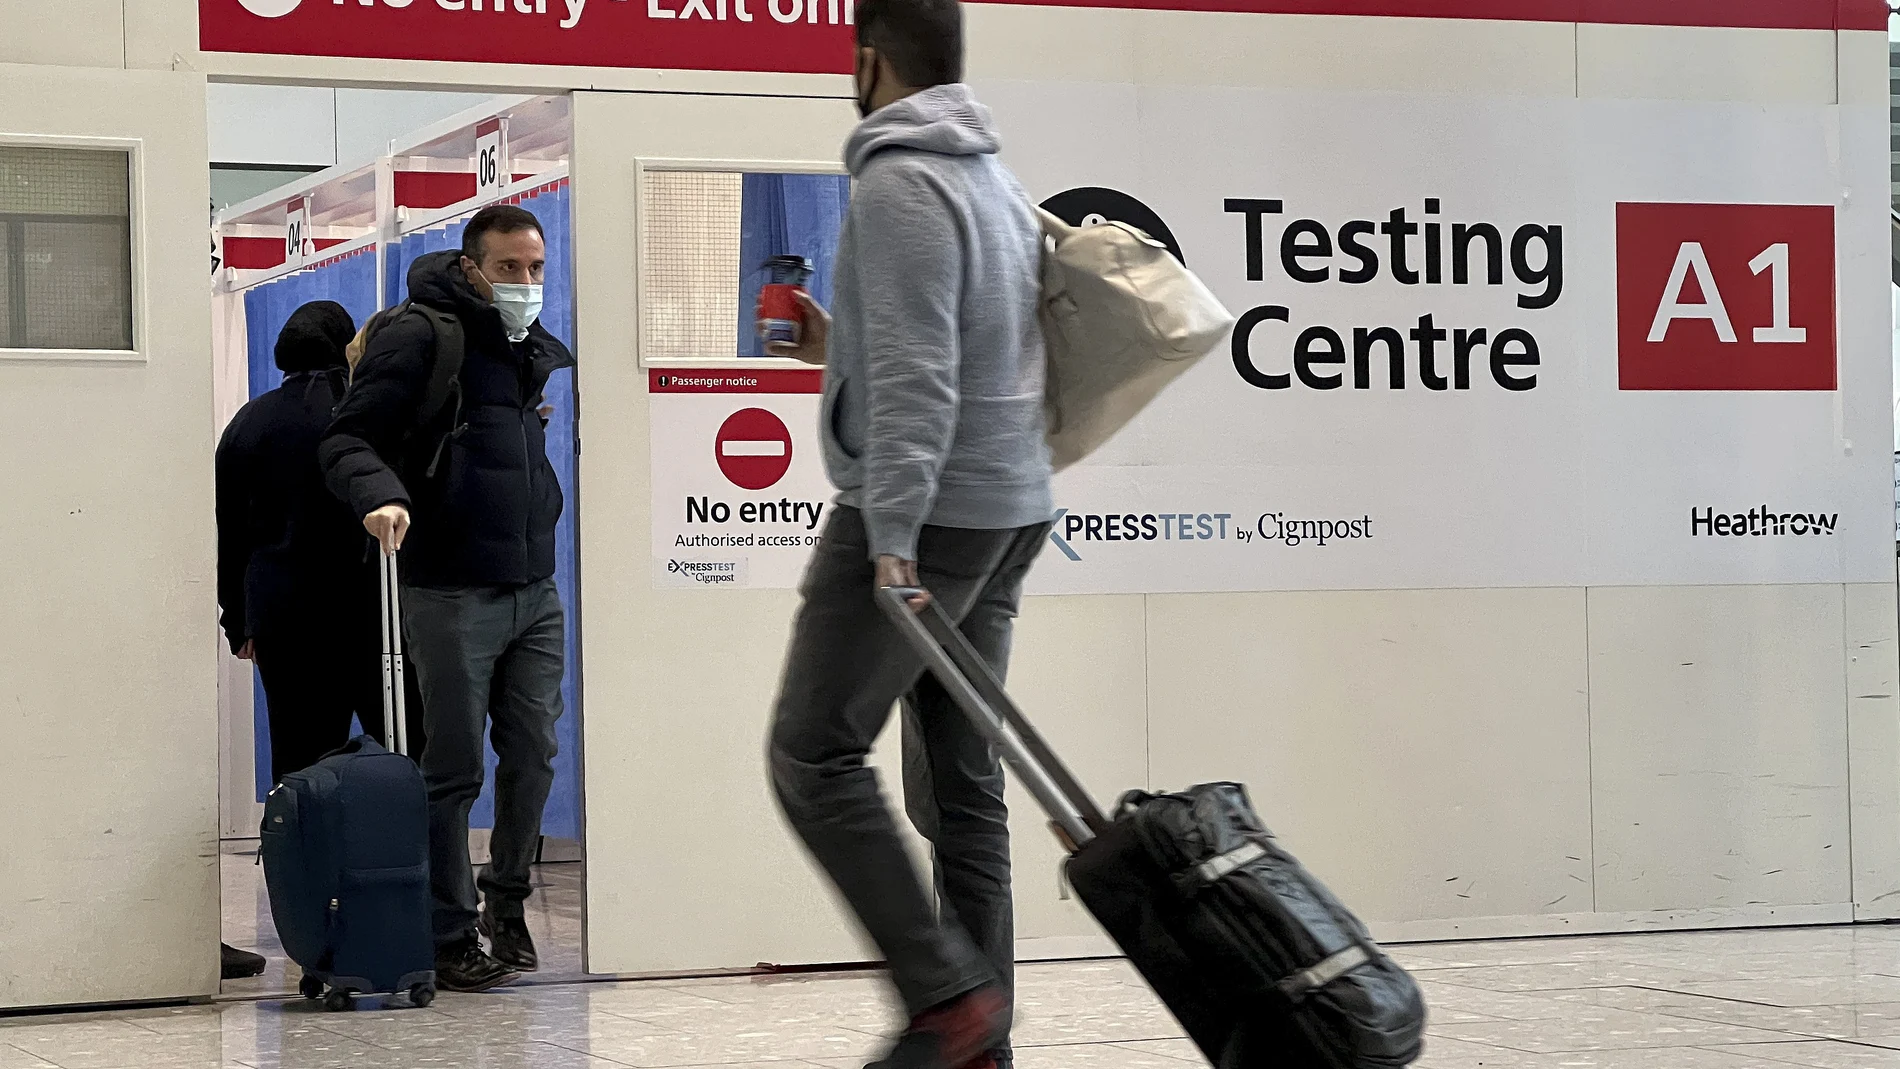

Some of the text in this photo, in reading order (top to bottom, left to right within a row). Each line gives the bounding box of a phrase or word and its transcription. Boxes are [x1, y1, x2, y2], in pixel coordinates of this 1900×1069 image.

[479, 144, 497, 188] 06
[288, 220, 302, 256] 04
[1223, 197, 1563, 310] Testing
[1647, 241, 1807, 344] A1
[1231, 304, 1541, 392] Centre
[671, 375, 758, 389] Passenger notice
[686, 496, 823, 530] No entry
[1236, 526, 1253, 544] by
[1257, 511, 1374, 547] Cignpost
[1691, 504, 1839, 537] Heathrow
[674, 532, 754, 548] Authorised
[758, 535, 801, 547] access
[667, 558, 736, 577] EXPRESSTEST
[695, 572, 735, 584] Cignpost
